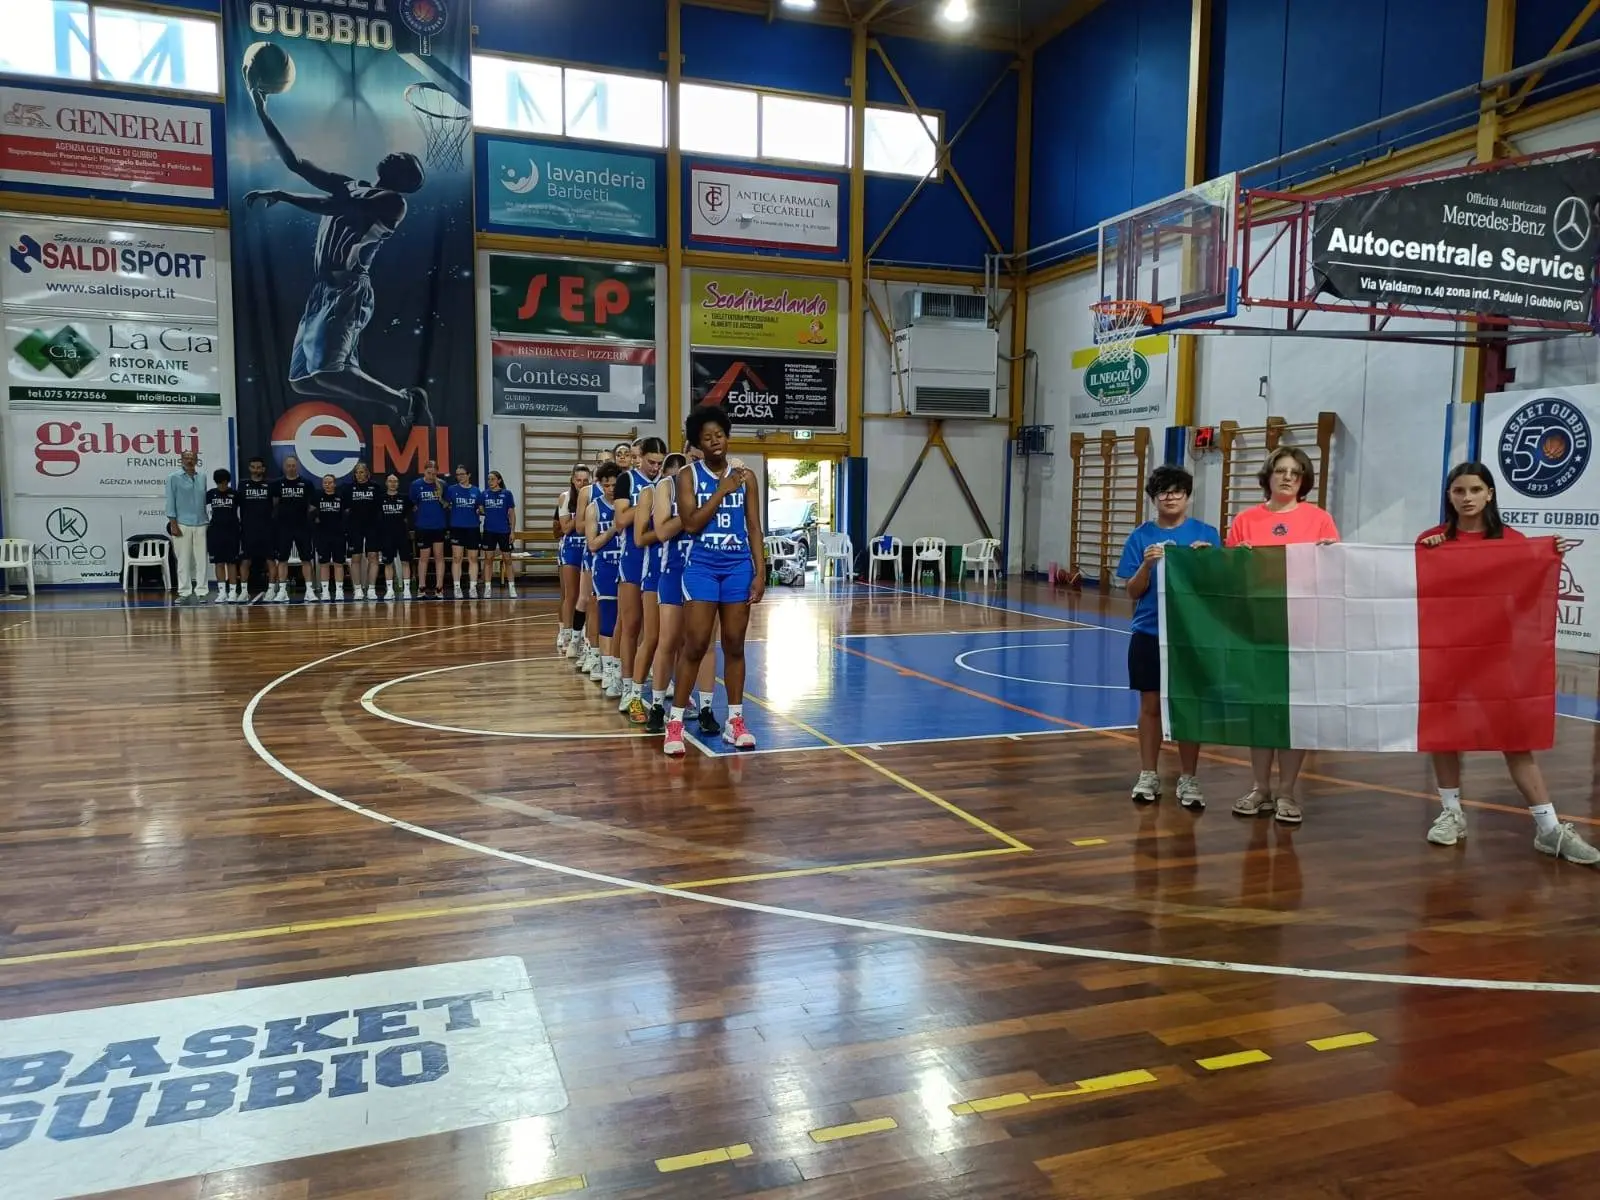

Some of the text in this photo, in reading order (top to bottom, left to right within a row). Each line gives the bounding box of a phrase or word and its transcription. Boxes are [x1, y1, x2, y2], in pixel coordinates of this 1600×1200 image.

[250, 2, 393, 51] GUBBIO
[56, 107, 204, 146] GENERALI
[56, 142, 85, 153] AGENZIA
[86, 145, 121, 156] GENERALE
[122, 148, 131, 157] DI
[547, 162, 646, 190] lavanderia
[547, 183, 609, 202] Barbetti
[736, 191, 831, 209] ANTICA FARMACIA
[752, 204, 814, 219] CECCARELLI
[1466, 191, 1546, 214] Officina Autorizzata
[1443, 205, 1546, 237] Mercedes-Benz
[54, 234, 106, 246] Specialisti
[137, 240, 166, 250] Sport
[1327, 227, 1586, 281] Autocentrale Service
[46, 282, 176, 300] www.saldisport.it
[517, 273, 631, 324] SEP
[702, 281, 828, 317] Scodinzolando
[1360, 277, 1377, 291] Via
[1424, 286, 1445, 298] n.40
[1446, 287, 1470, 298] zona
[1472, 288, 1491, 300] ind.
[1493, 289, 1524, 304] Padule
[1530, 294, 1562, 310] Gubbio
[1562, 298, 1584, 312] (PG)
[108, 325, 149, 350] La
[518, 346, 580, 358] RISTORANTE
[586, 350, 629, 360] PIZZERIA
[109, 358, 189, 371] RISTORANTE
[110, 372, 179, 386] CATERING
[506, 362, 603, 387] Contessa
[66, 390, 108, 400] 9273566
[136, 392, 197, 404] info@lacia.it
[728, 390, 779, 405] Edilizia
[734, 404, 774, 418] CASA
[1502, 403, 1587, 452] BASKET GUBBIO
[35, 421, 202, 477] gabetti
[1512, 426, 1574, 482] 50
[126, 458, 203, 468] FRANCHISG
[99, 478, 132, 486] AGENZIA
[1527, 482, 1548, 492] 1973
[1555, 466, 1577, 487] 2023
[697, 492, 744, 509] ITLIA
[716, 512, 731, 528] 18
[1502, 512, 1599, 526] SKET GUBBIO
[704, 542, 741, 552] AIRWAYS
[0, 990, 494, 1098] BASKET
